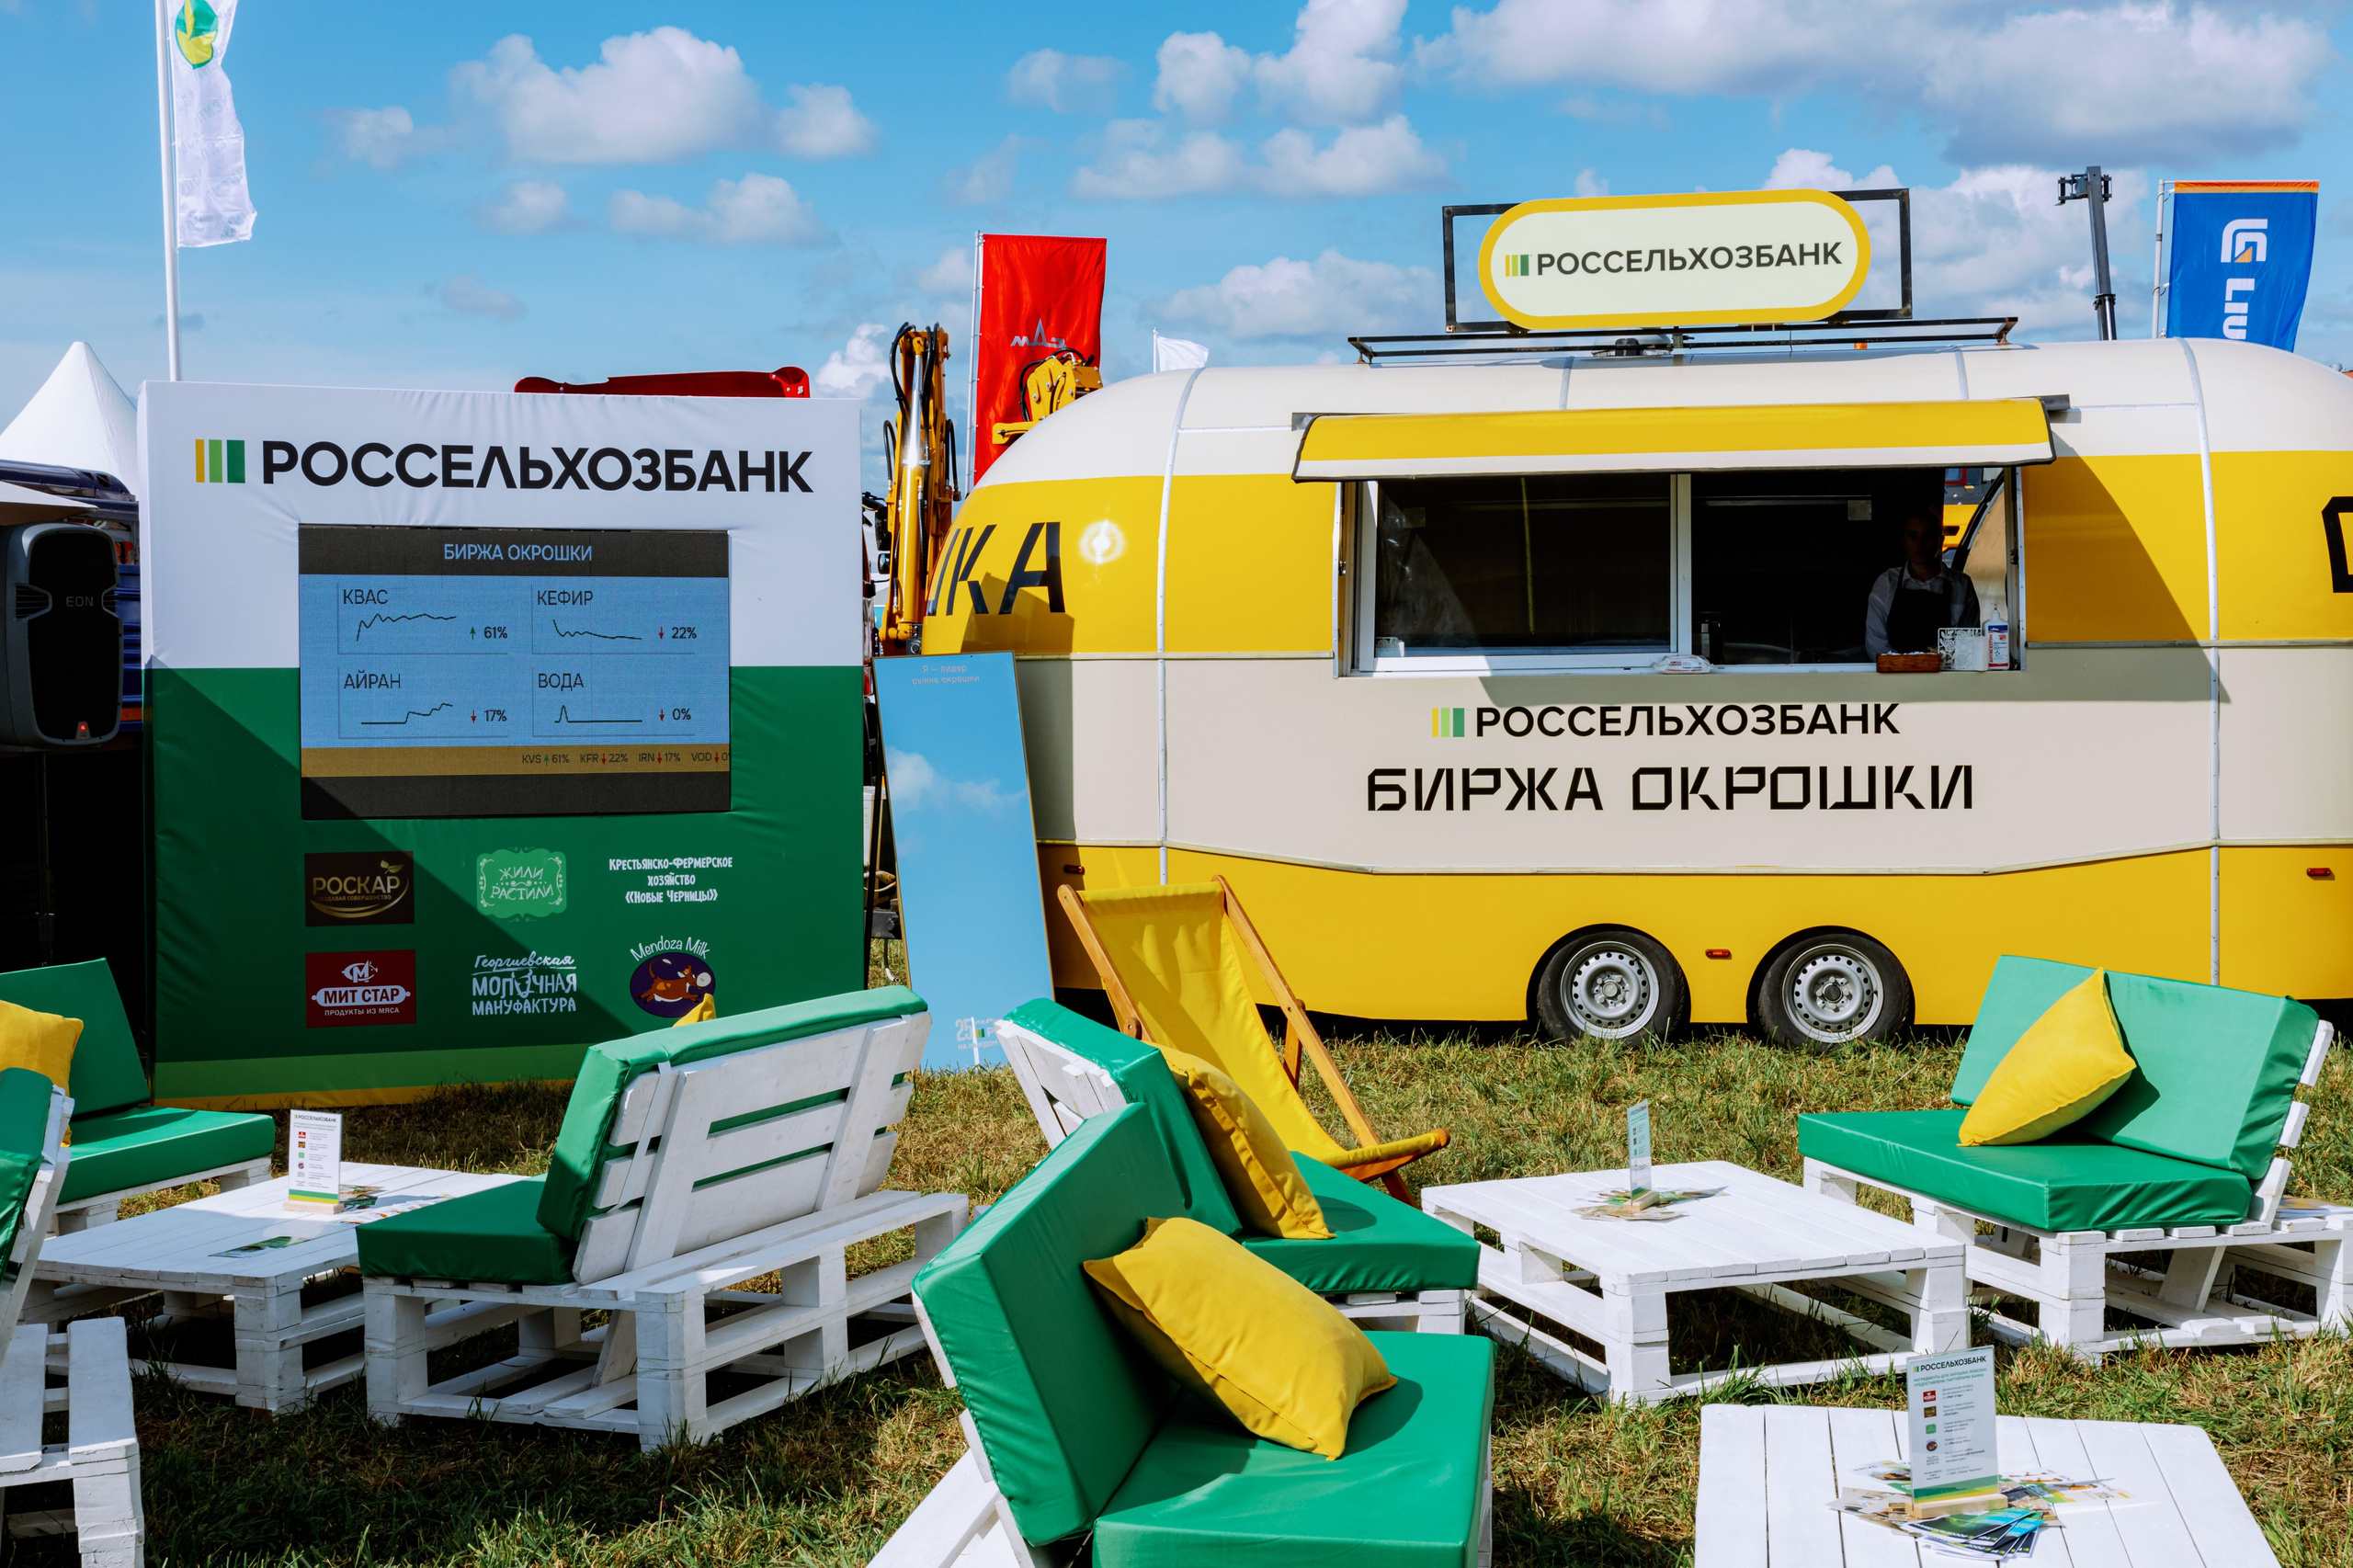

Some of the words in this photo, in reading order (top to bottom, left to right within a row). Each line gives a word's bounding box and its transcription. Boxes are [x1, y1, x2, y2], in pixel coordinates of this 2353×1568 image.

[1537, 241, 1843, 276] РОССЕЛЬХОЗБАНК
[262, 439, 814, 494] РОССЕЛЬХОЗБАНК
[443, 543, 504, 562] БИРЖА
[507, 544, 594, 562] ОКРОШКИ
[65, 596, 95, 608] EON
[342, 588, 390, 606] КВАС
[537, 588, 594, 607] КЕФИР
[483, 626, 508, 640] 61%
[671, 626, 698, 640] 22%
[922, 665, 928, 673] Я
[343, 670, 402, 689] АЙРАН
[538, 672, 585, 691] ВОДА
[483, 709, 508, 722] 17%
[672, 708, 692, 722] 0%
[1476, 702, 1901, 738] РОССЕЛЬХОЗБАНК
[521, 754, 542, 765] KVS
[551, 754, 570, 764] 61%
[580, 754, 599, 765] KFR
[608, 754, 629, 764] 22%
[638, 753, 655, 764] IRN
[664, 753, 681, 764] 17%
[690, 752, 712, 763] VOD
[1366, 767, 1605, 812] БИРЖА
[1631, 765, 1974, 812] ОКРОШКИ
[498, 866, 544, 881] ЖИЛИ
[647, 872, 696, 887] ХОЗЯЙСТВО
[313, 875, 401, 895] РОСКАР
[490, 883, 554, 901] РАСТИЛИ
[630, 936, 683, 961] Mendoza
[685, 936, 710, 960] Milk
[473, 950, 575, 972] Георгиевская
[324, 989, 358, 1004] МИТ
[361, 987, 400, 1003] СТАР
[324, 1008, 365, 1017] ПРОДУКТЫ
[472, 996, 576, 1017] МАНУФАКТУРА
[955, 1017, 972, 1042] 25
[299, 1114, 337, 1122] РОССЕЛЬХОЗБАНК
[1920, 1356, 1987, 1372] РОССЕЛЬХОЗБАНК
